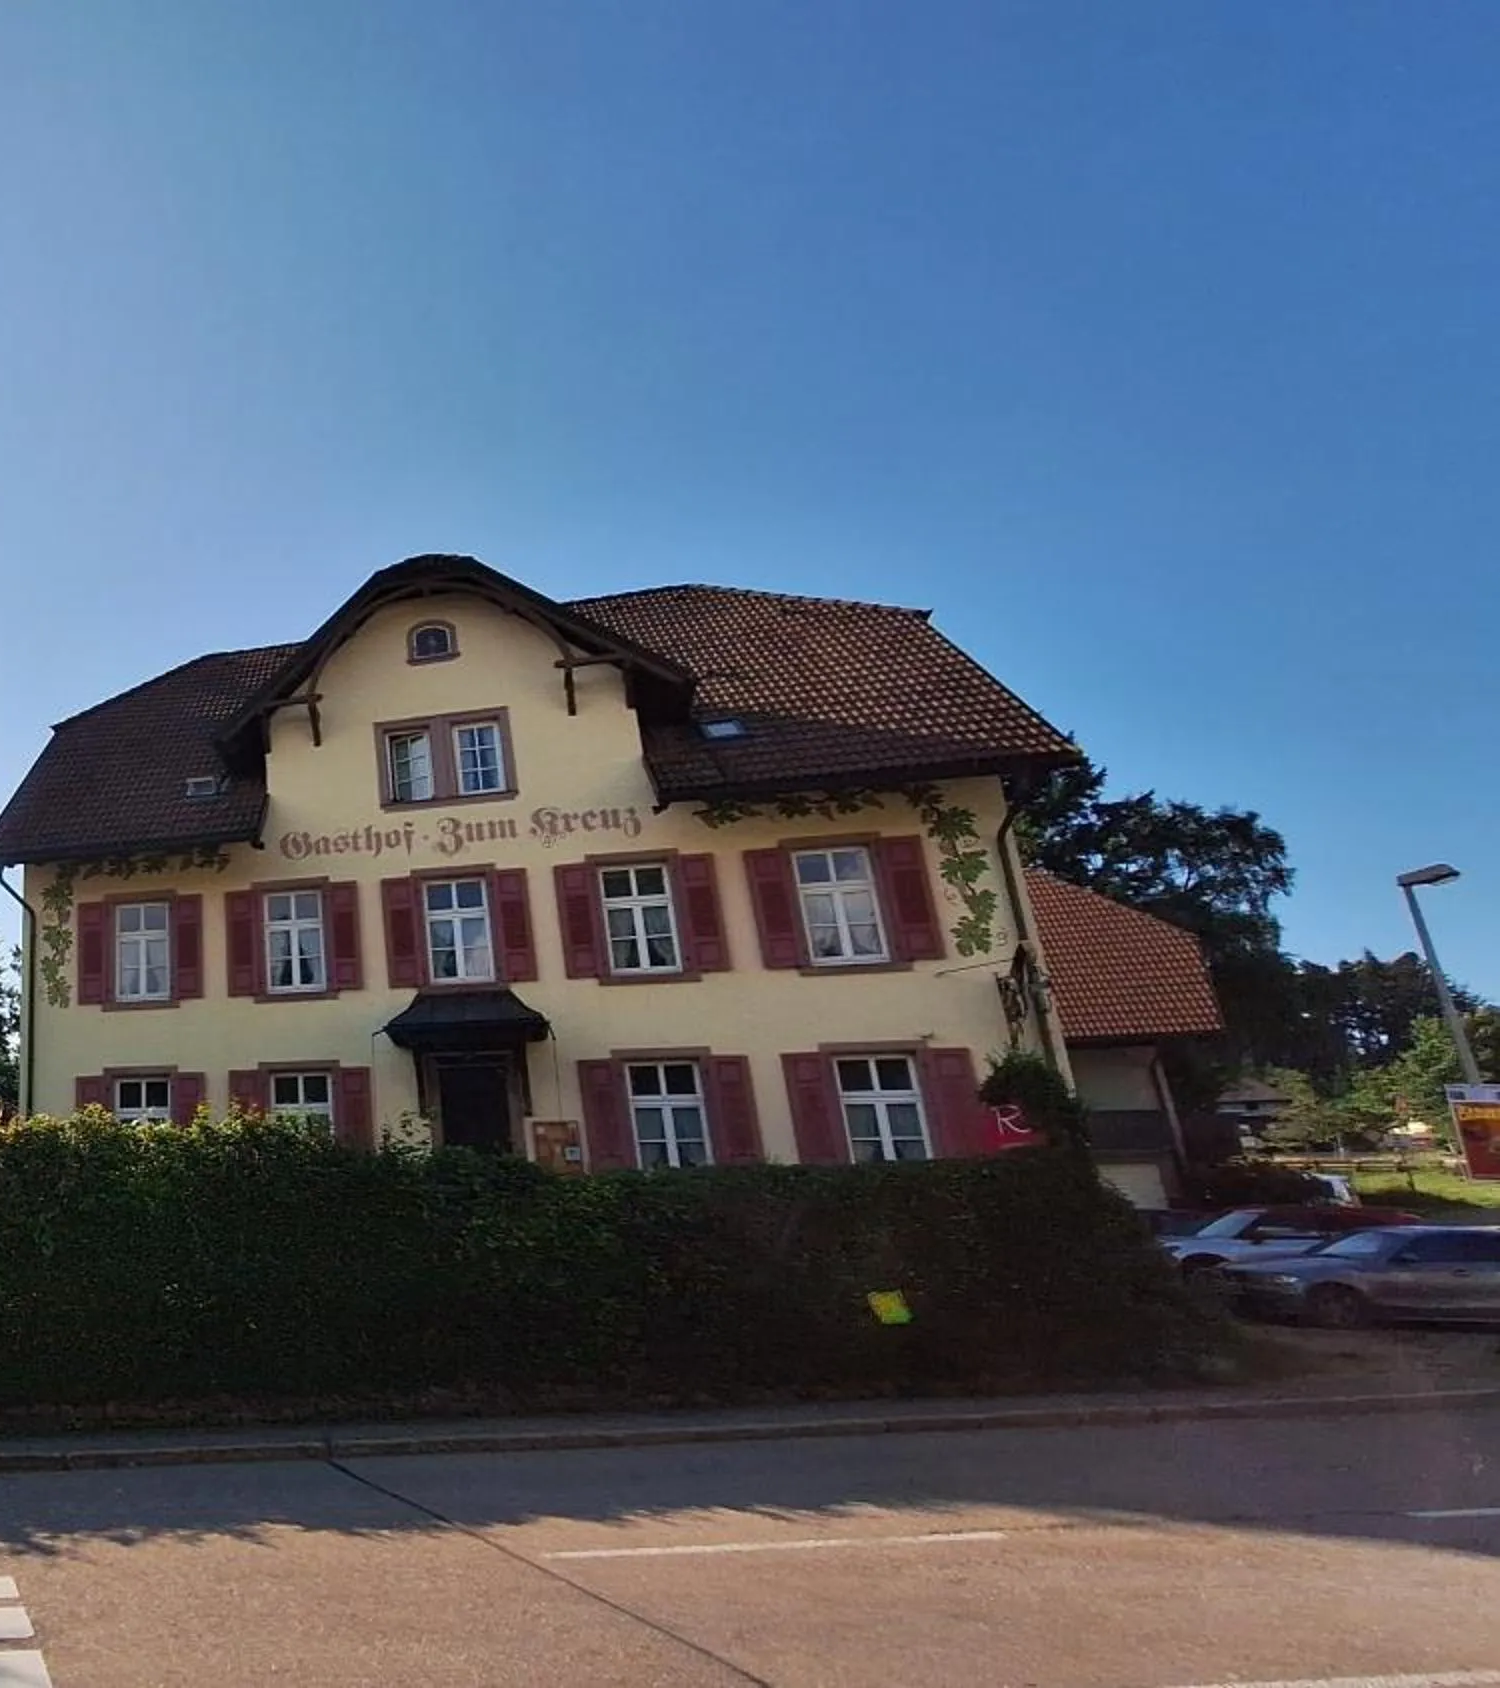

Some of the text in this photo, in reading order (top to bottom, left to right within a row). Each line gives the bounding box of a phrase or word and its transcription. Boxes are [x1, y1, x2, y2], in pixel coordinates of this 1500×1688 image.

[280, 821, 415, 860] Gasthof
[530, 806, 642, 842] Kreuz
[990, 1104, 1032, 1135] R
